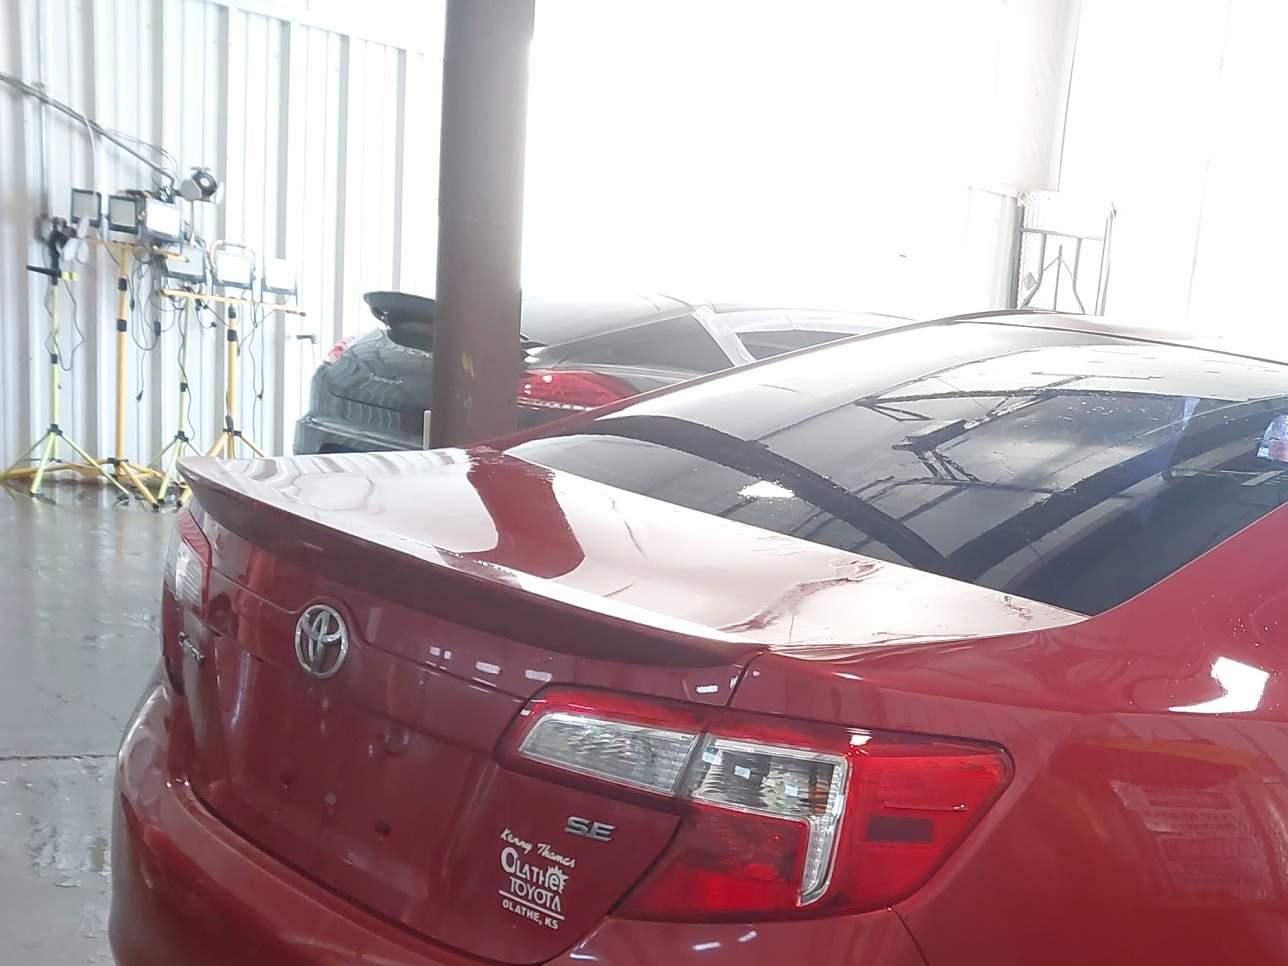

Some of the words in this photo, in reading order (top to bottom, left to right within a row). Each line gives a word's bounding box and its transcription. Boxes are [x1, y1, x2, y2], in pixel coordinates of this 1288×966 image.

[500, 828, 533, 854] Kenny
[564, 816, 616, 841] SE
[509, 876, 561, 912] TOYOTA
[502, 899, 543, 925] OLATHE,
[544, 917, 560, 930] KS
